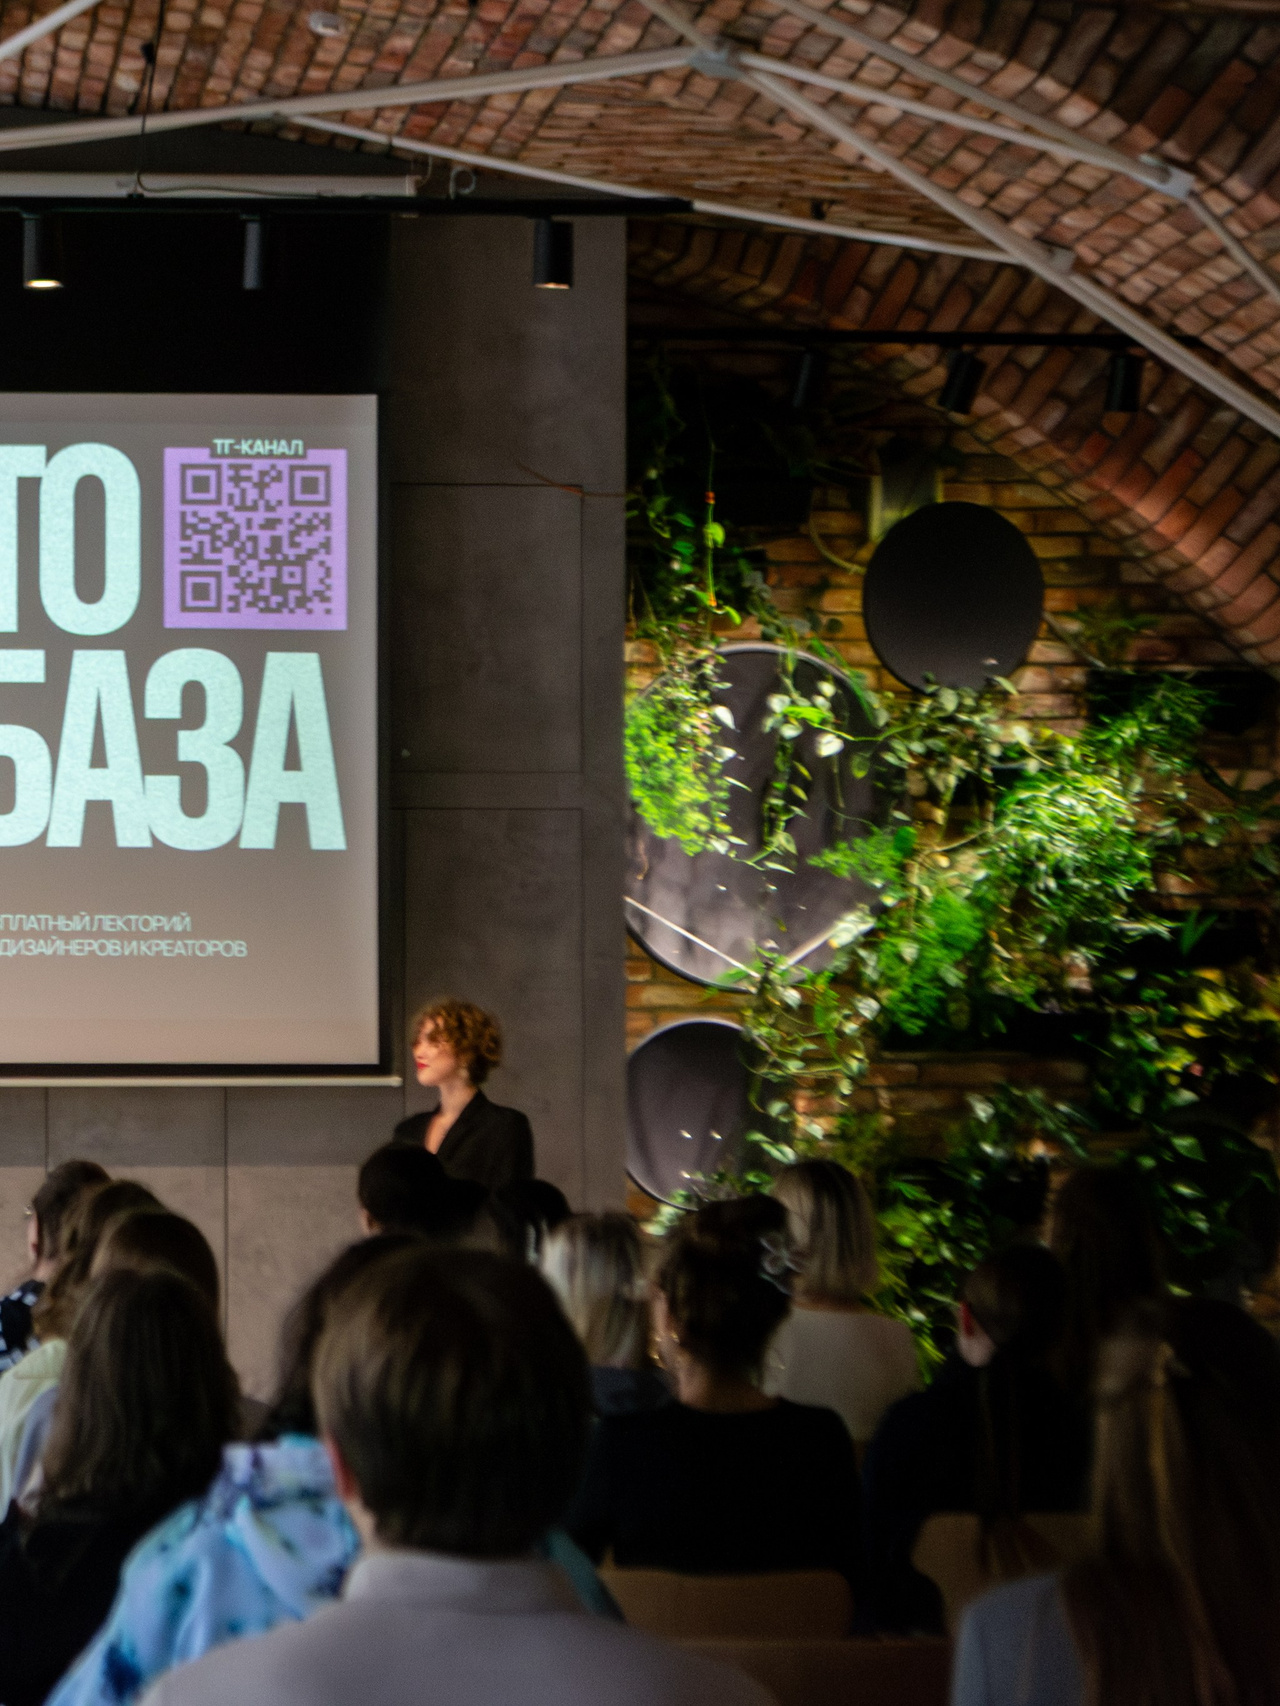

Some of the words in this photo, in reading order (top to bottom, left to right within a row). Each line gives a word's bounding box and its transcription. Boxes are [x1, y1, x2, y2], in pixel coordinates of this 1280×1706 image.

[212, 438, 304, 456] ТГ-КАНАЛ
[92, 911, 192, 932] ЛЕКТОРИЙ
[123, 940, 139, 957] И
[140, 939, 249, 958] КРЕАТОРОВ
